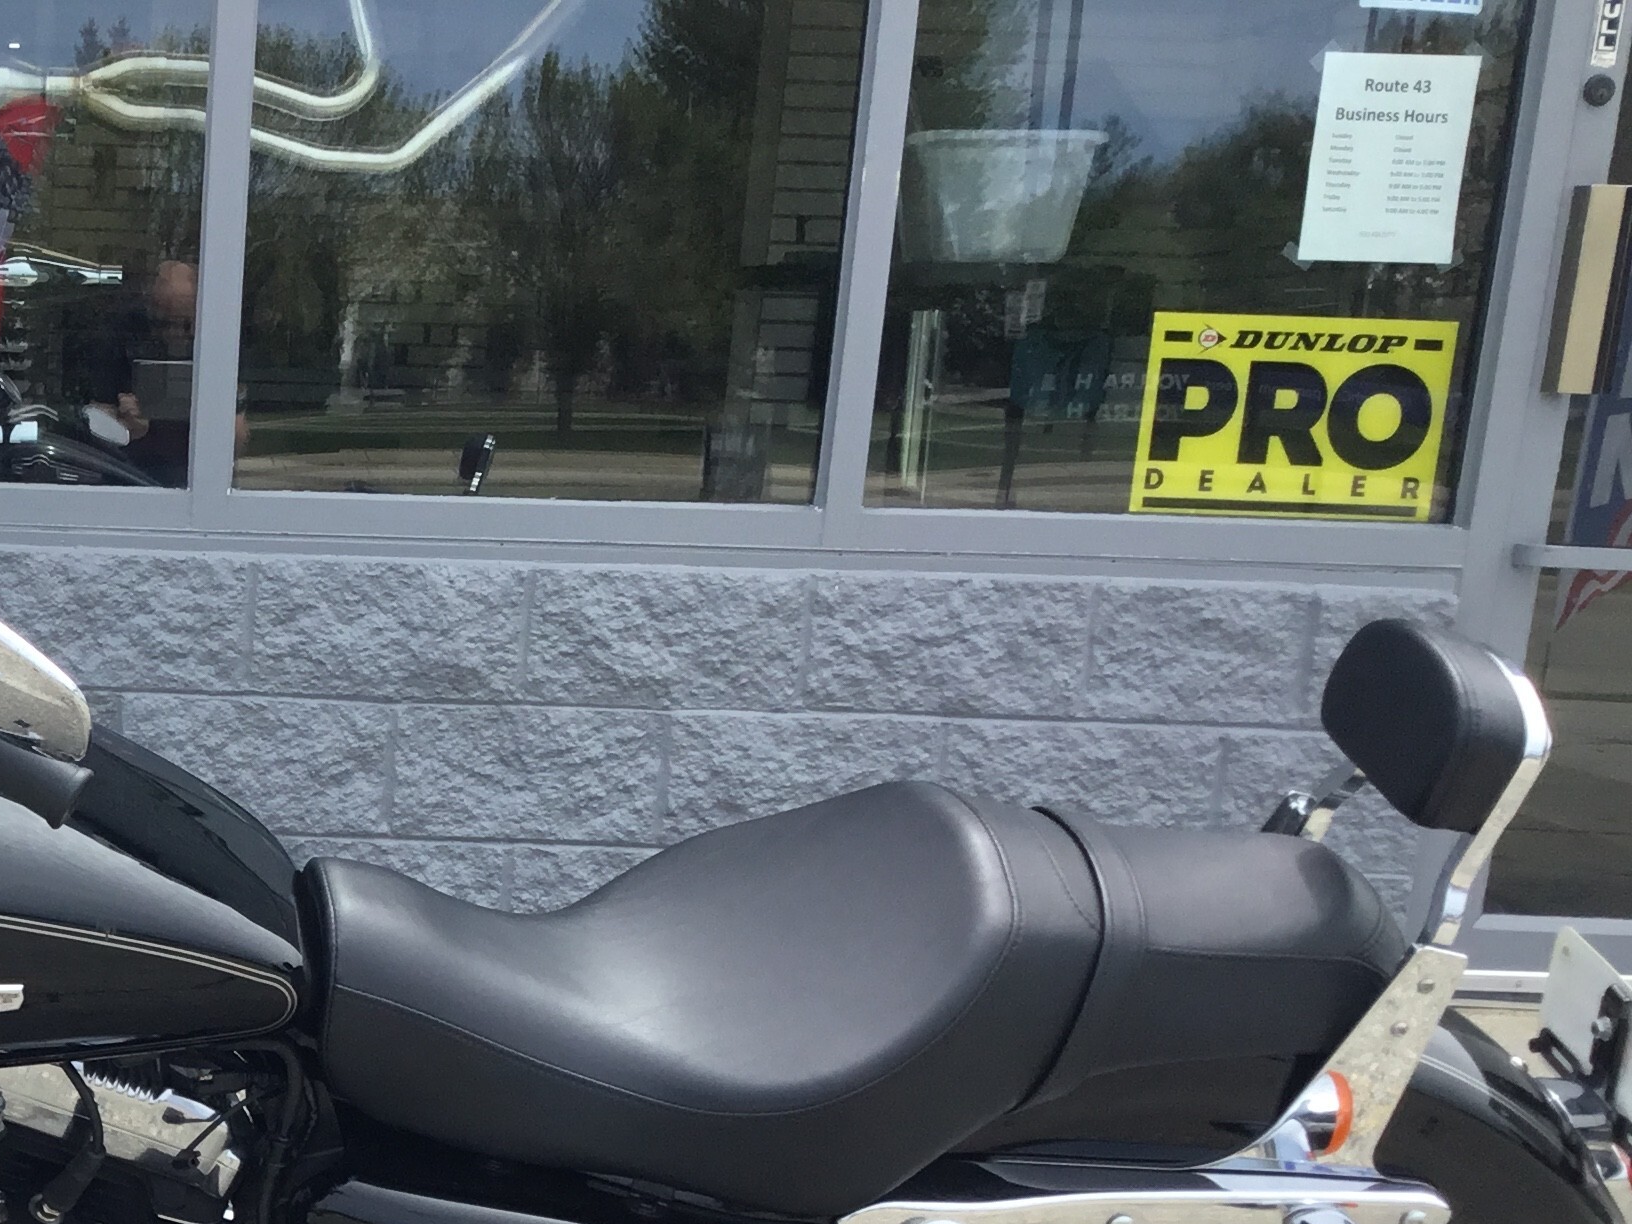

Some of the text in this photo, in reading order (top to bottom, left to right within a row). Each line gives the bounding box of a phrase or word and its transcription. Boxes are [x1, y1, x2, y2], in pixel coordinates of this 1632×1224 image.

[1598, 0, 1621, 50] ULL
[1364, 78, 1432, 94] Route 43
[1335, 107, 1449, 124] Business Hours
[1229, 330, 1408, 353] DUNLOP
[1148, 357, 1432, 470] PRO
[1144, 468, 1420, 499] DEALER
